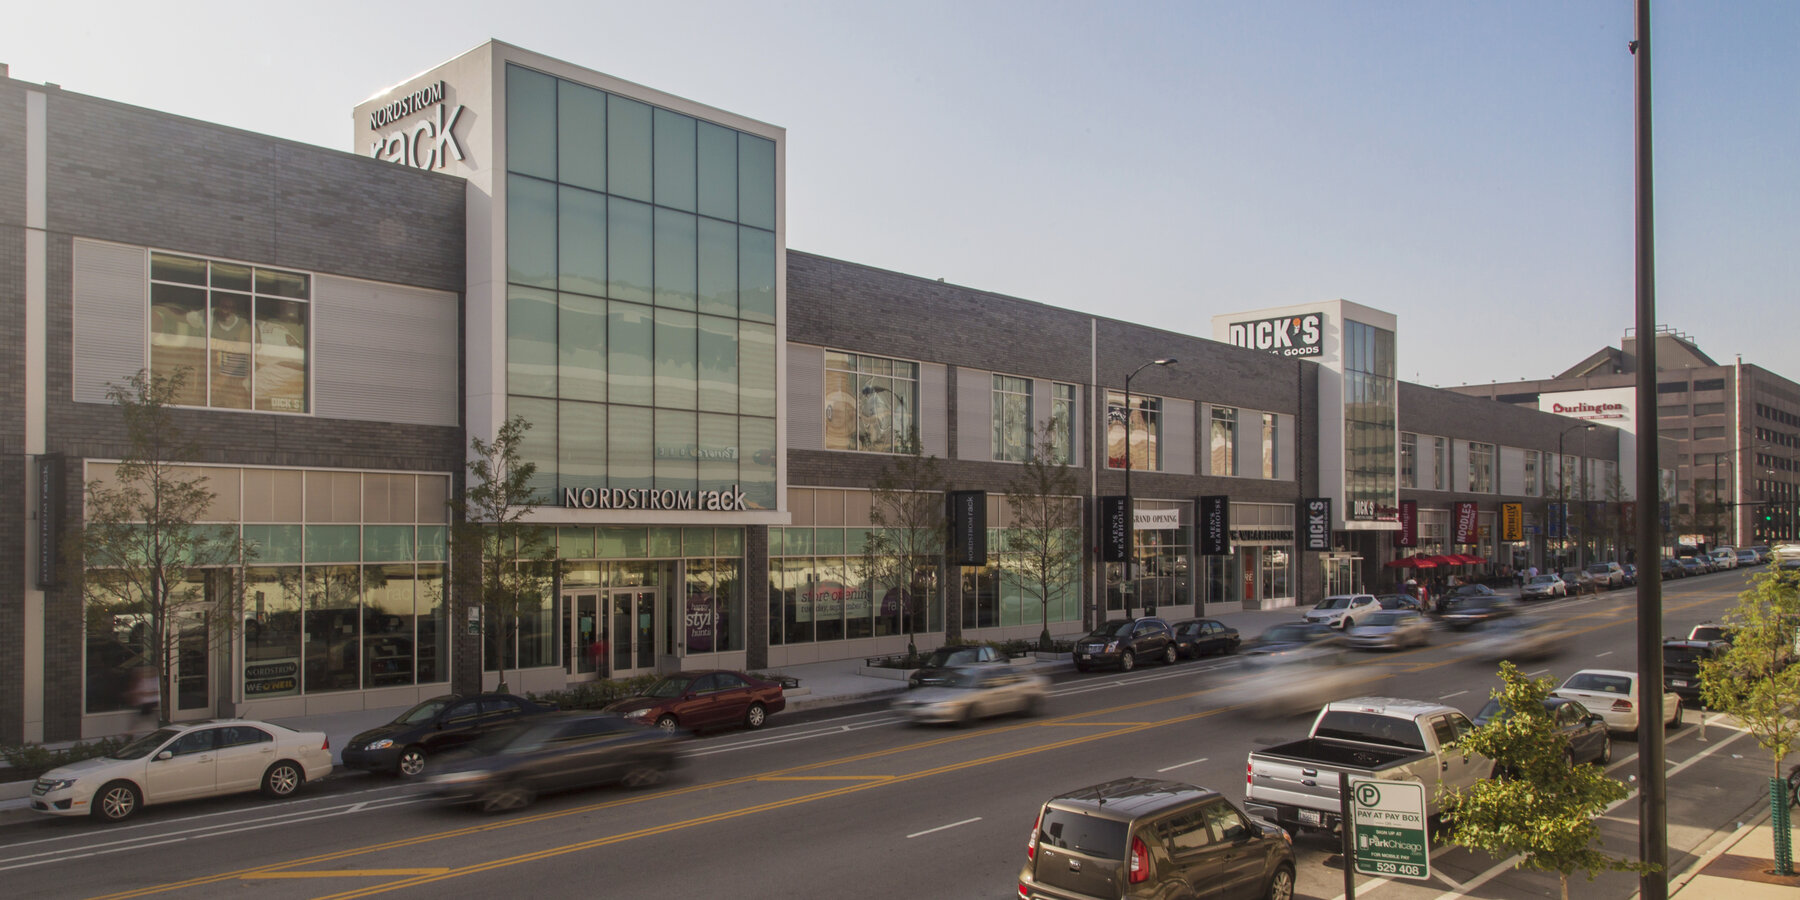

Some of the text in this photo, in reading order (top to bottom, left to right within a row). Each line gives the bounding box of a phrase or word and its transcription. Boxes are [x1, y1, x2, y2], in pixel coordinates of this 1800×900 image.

[369, 80, 445, 131] NORDSTROM
[1230, 315, 1320, 350] DICK'S
[1284, 346, 1319, 356] GOODS
[1553, 402, 1623, 414] Burlington
[564, 484, 747, 511] NORDSTROM rack
[966, 496, 975, 516] rack
[1152, 514, 1178, 524] OPENING
[1309, 501, 1324, 549] DICK'S
[1456, 503, 1472, 543] NOODLES
[686, 609, 720, 630] style
[1369, 837, 1422, 853] ParkChicago
[1376, 862, 1420, 876] 529 408
